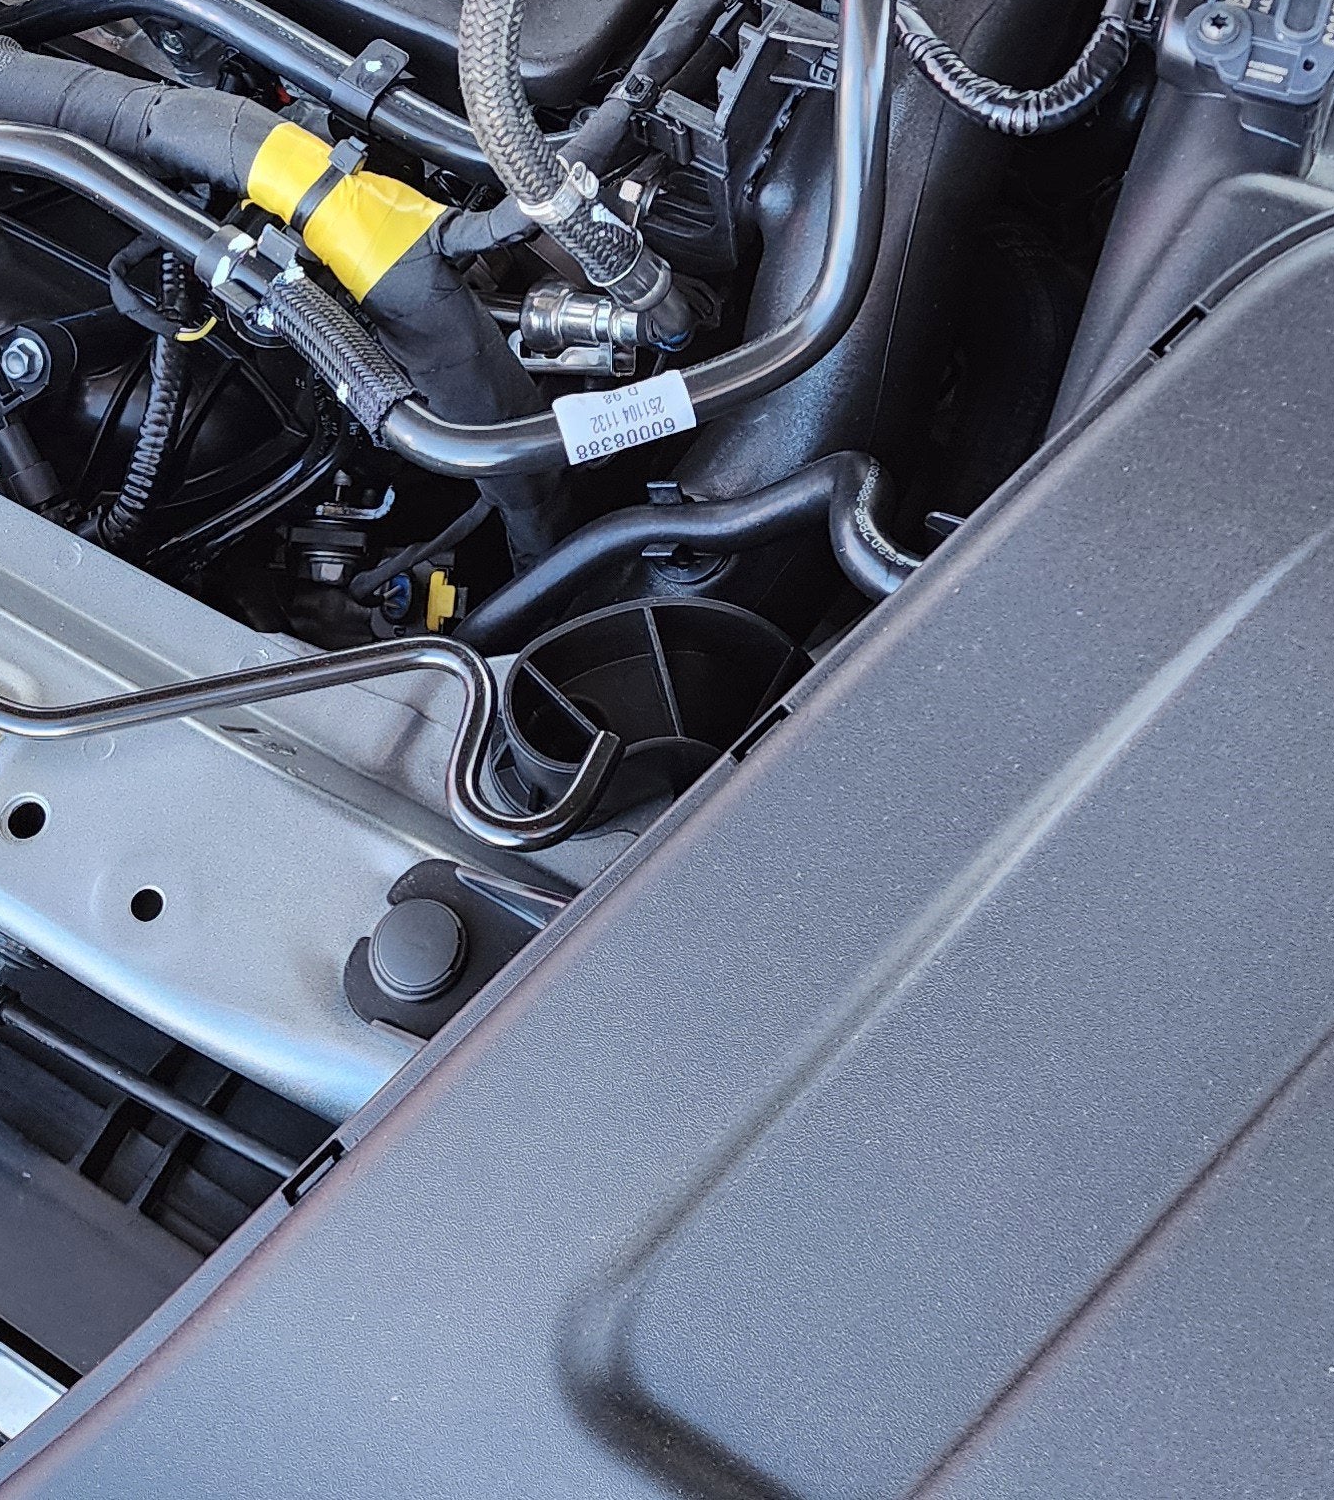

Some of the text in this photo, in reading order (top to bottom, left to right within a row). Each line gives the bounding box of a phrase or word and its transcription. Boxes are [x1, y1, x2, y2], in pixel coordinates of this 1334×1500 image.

[590, 396, 665, 434] 251104 1132
[576, 417, 676, 460] 60008388
